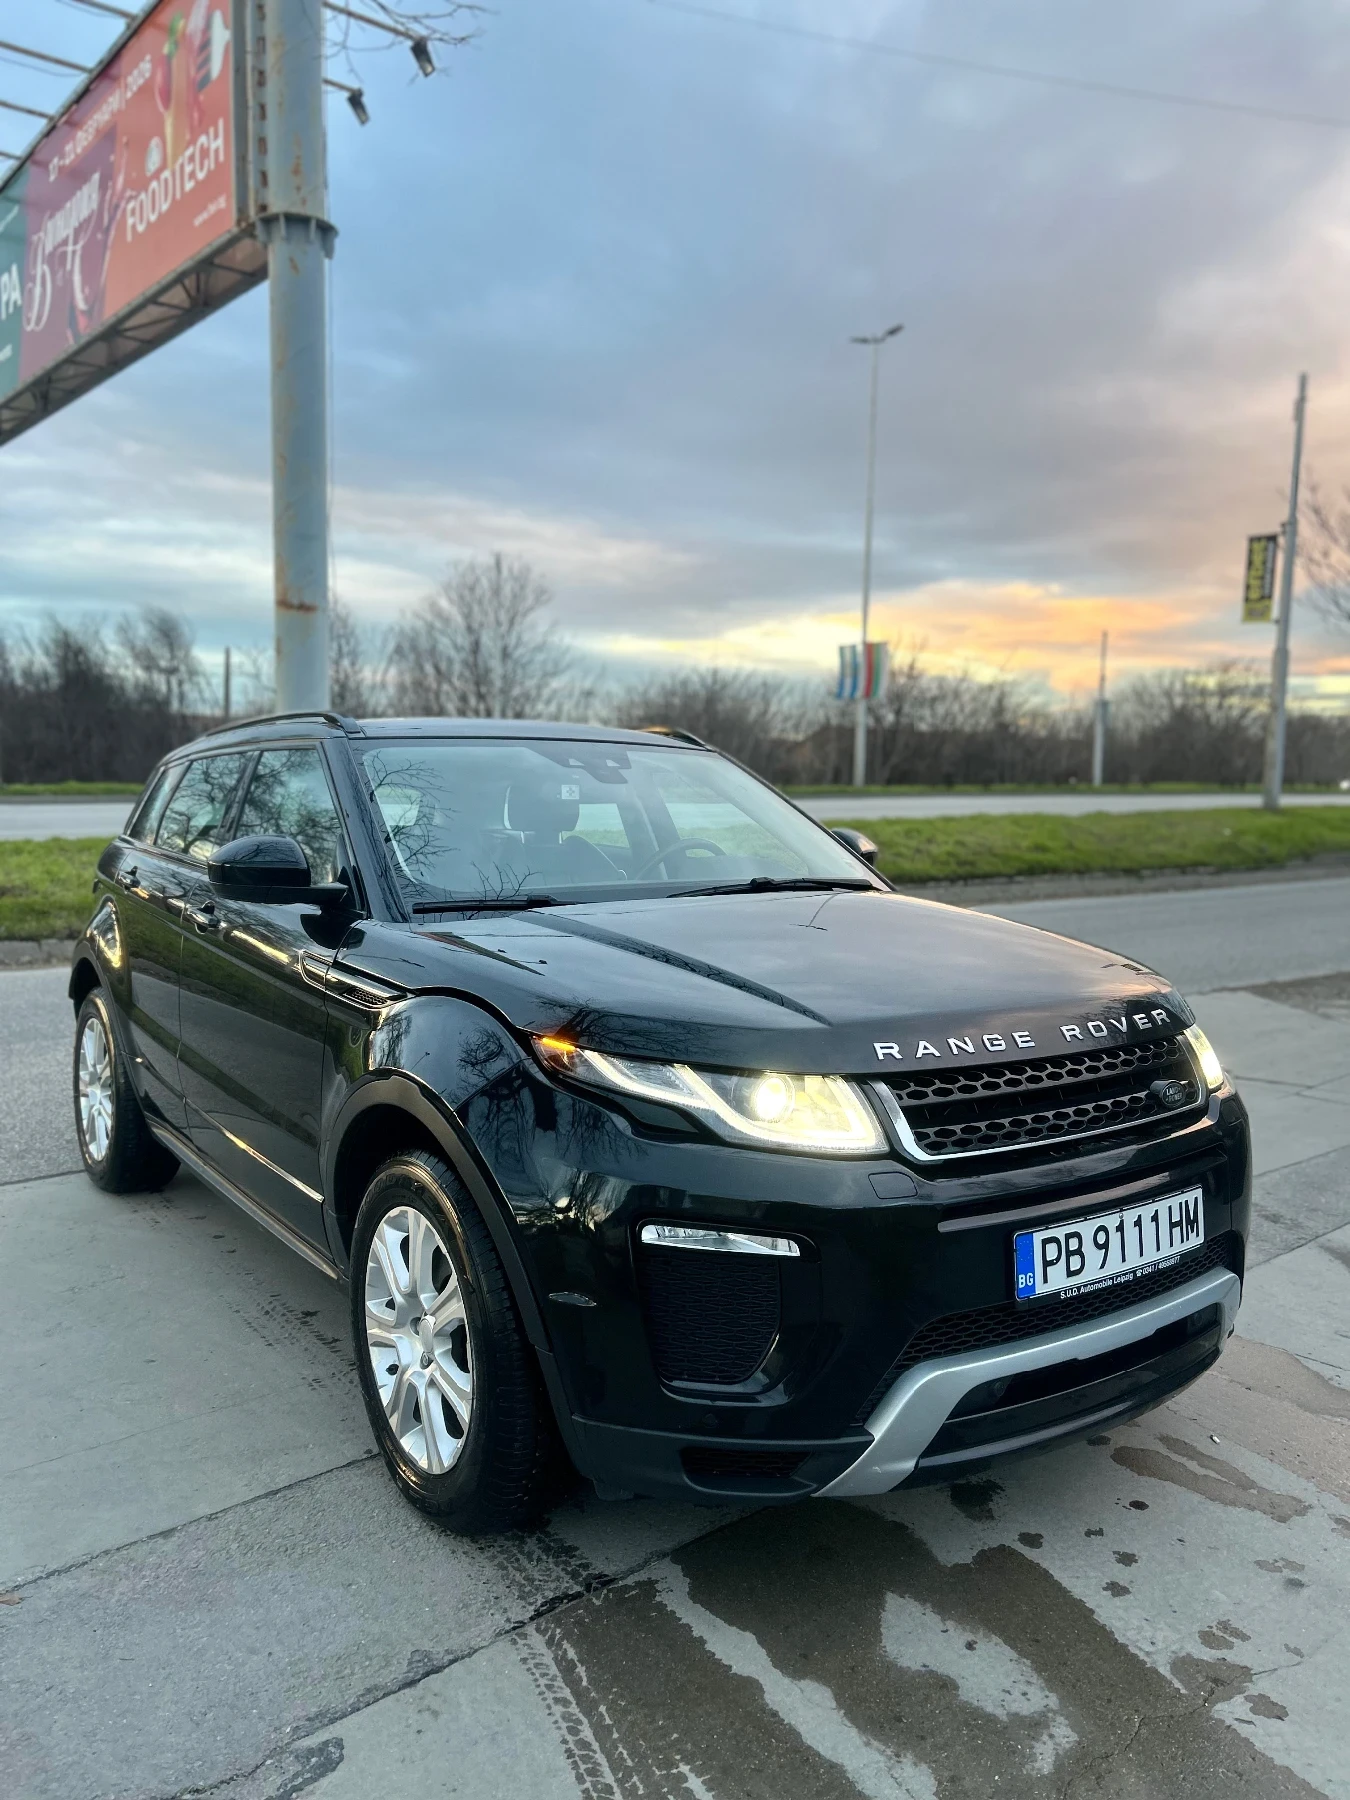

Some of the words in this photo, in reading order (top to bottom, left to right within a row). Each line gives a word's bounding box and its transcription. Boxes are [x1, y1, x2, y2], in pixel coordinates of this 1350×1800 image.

[126, 117, 225, 242] FOODTECH
[873, 1030, 1036, 1061] RANGE
[1060, 1008, 1172, 1043] ROVER
[1041, 1231, 1086, 1284] PB
[1092, 1208, 1161, 1270] 9111
[1168, 1196, 1200, 1248] HM
[1018, 1272, 1034, 1289] BG
[1060, 1287, 1079, 1299] S.U.D.
[1080, 1276, 1112, 1294] Automobile
[1113, 1273, 1134, 1285] Leipzig
